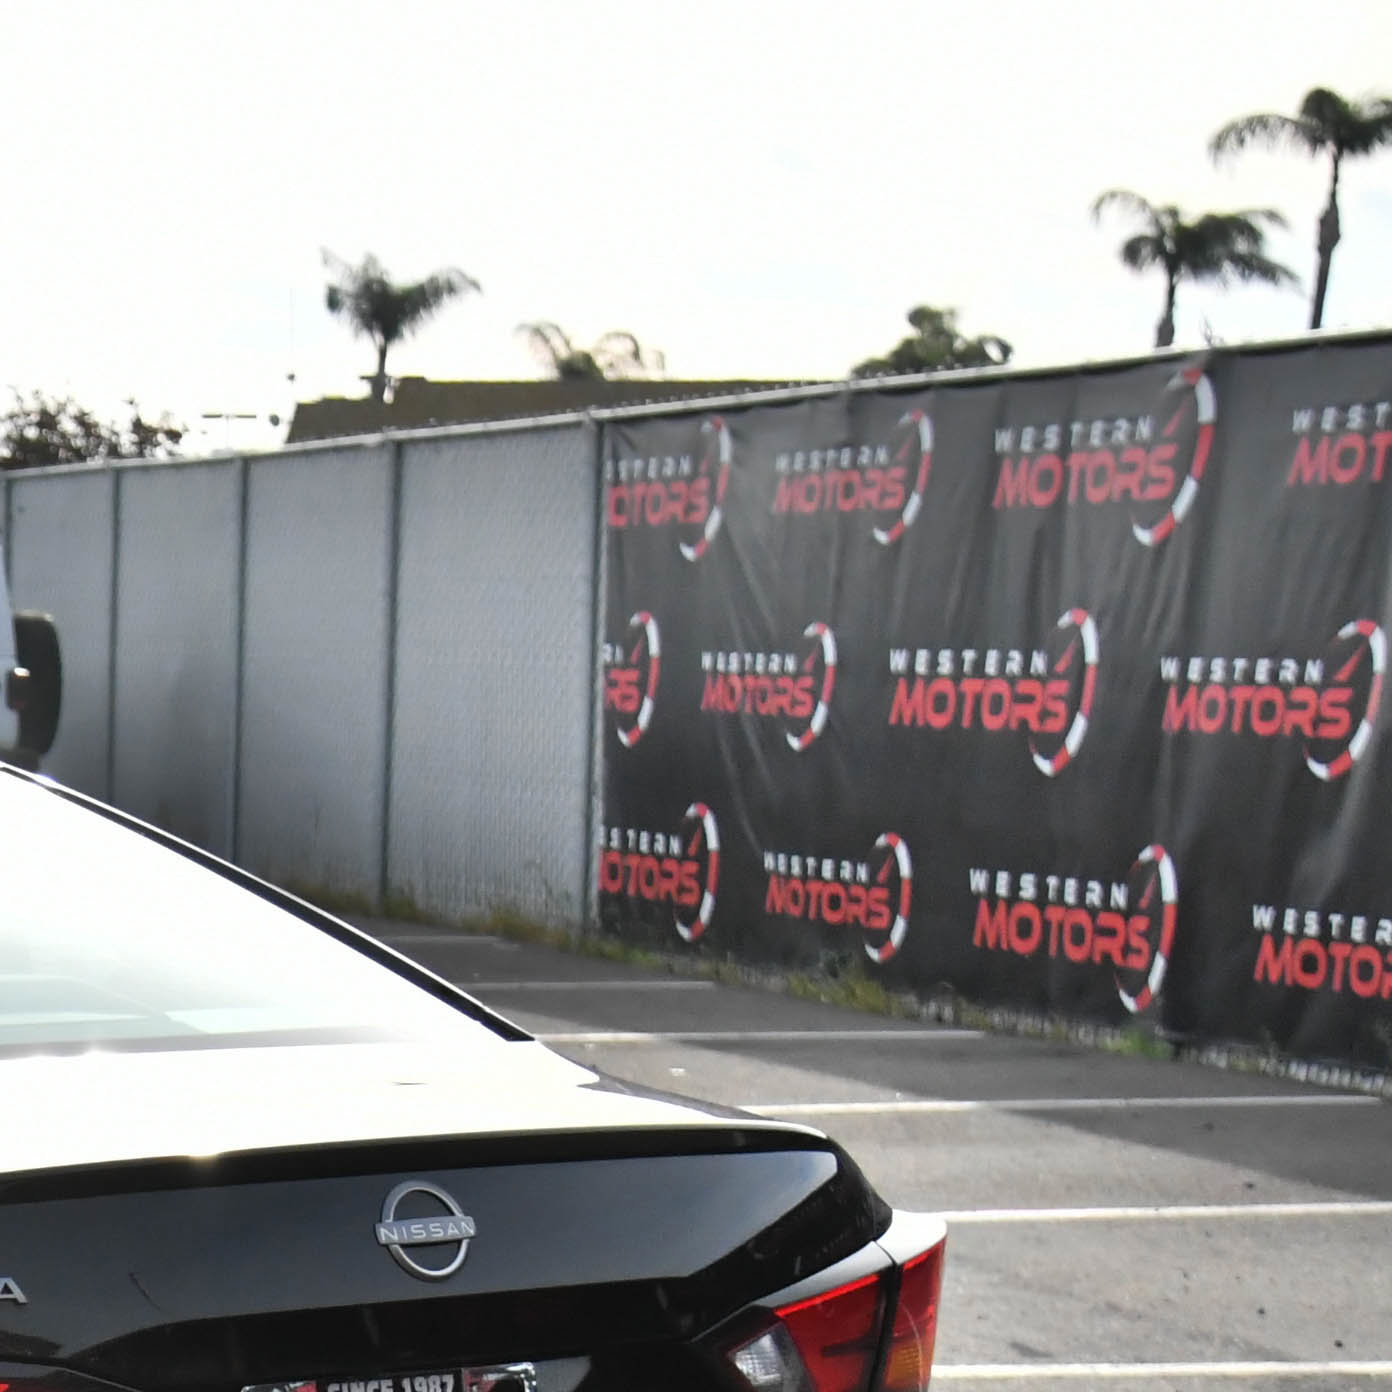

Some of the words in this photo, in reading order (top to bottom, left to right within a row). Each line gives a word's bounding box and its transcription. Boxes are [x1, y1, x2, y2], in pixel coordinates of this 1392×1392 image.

[995, 415, 1152, 453] WESTERN
[776, 444, 890, 473] WESTERN
[992, 443, 1179, 509] MOTORS
[772, 465, 906, 514] MOTORS
[701, 651, 797, 673] WESTERN
[890, 648, 1047, 676] WESTERN
[1160, 656, 1323, 684] WESTERN
[700, 672, 815, 718] MOTORS
[889, 676, 1069, 733] MOTORS
[1162, 684, 1353, 739] MOTORS
[599, 848, 700, 906] OTORS
[764, 851, 868, 883] WESTERN
[969, 868, 1130, 910] WESTERN
[765, 873, 890, 929] MOTORS
[973, 898, 1151, 970] MOTORS
[379, 1221, 475, 1242] NISSAN
